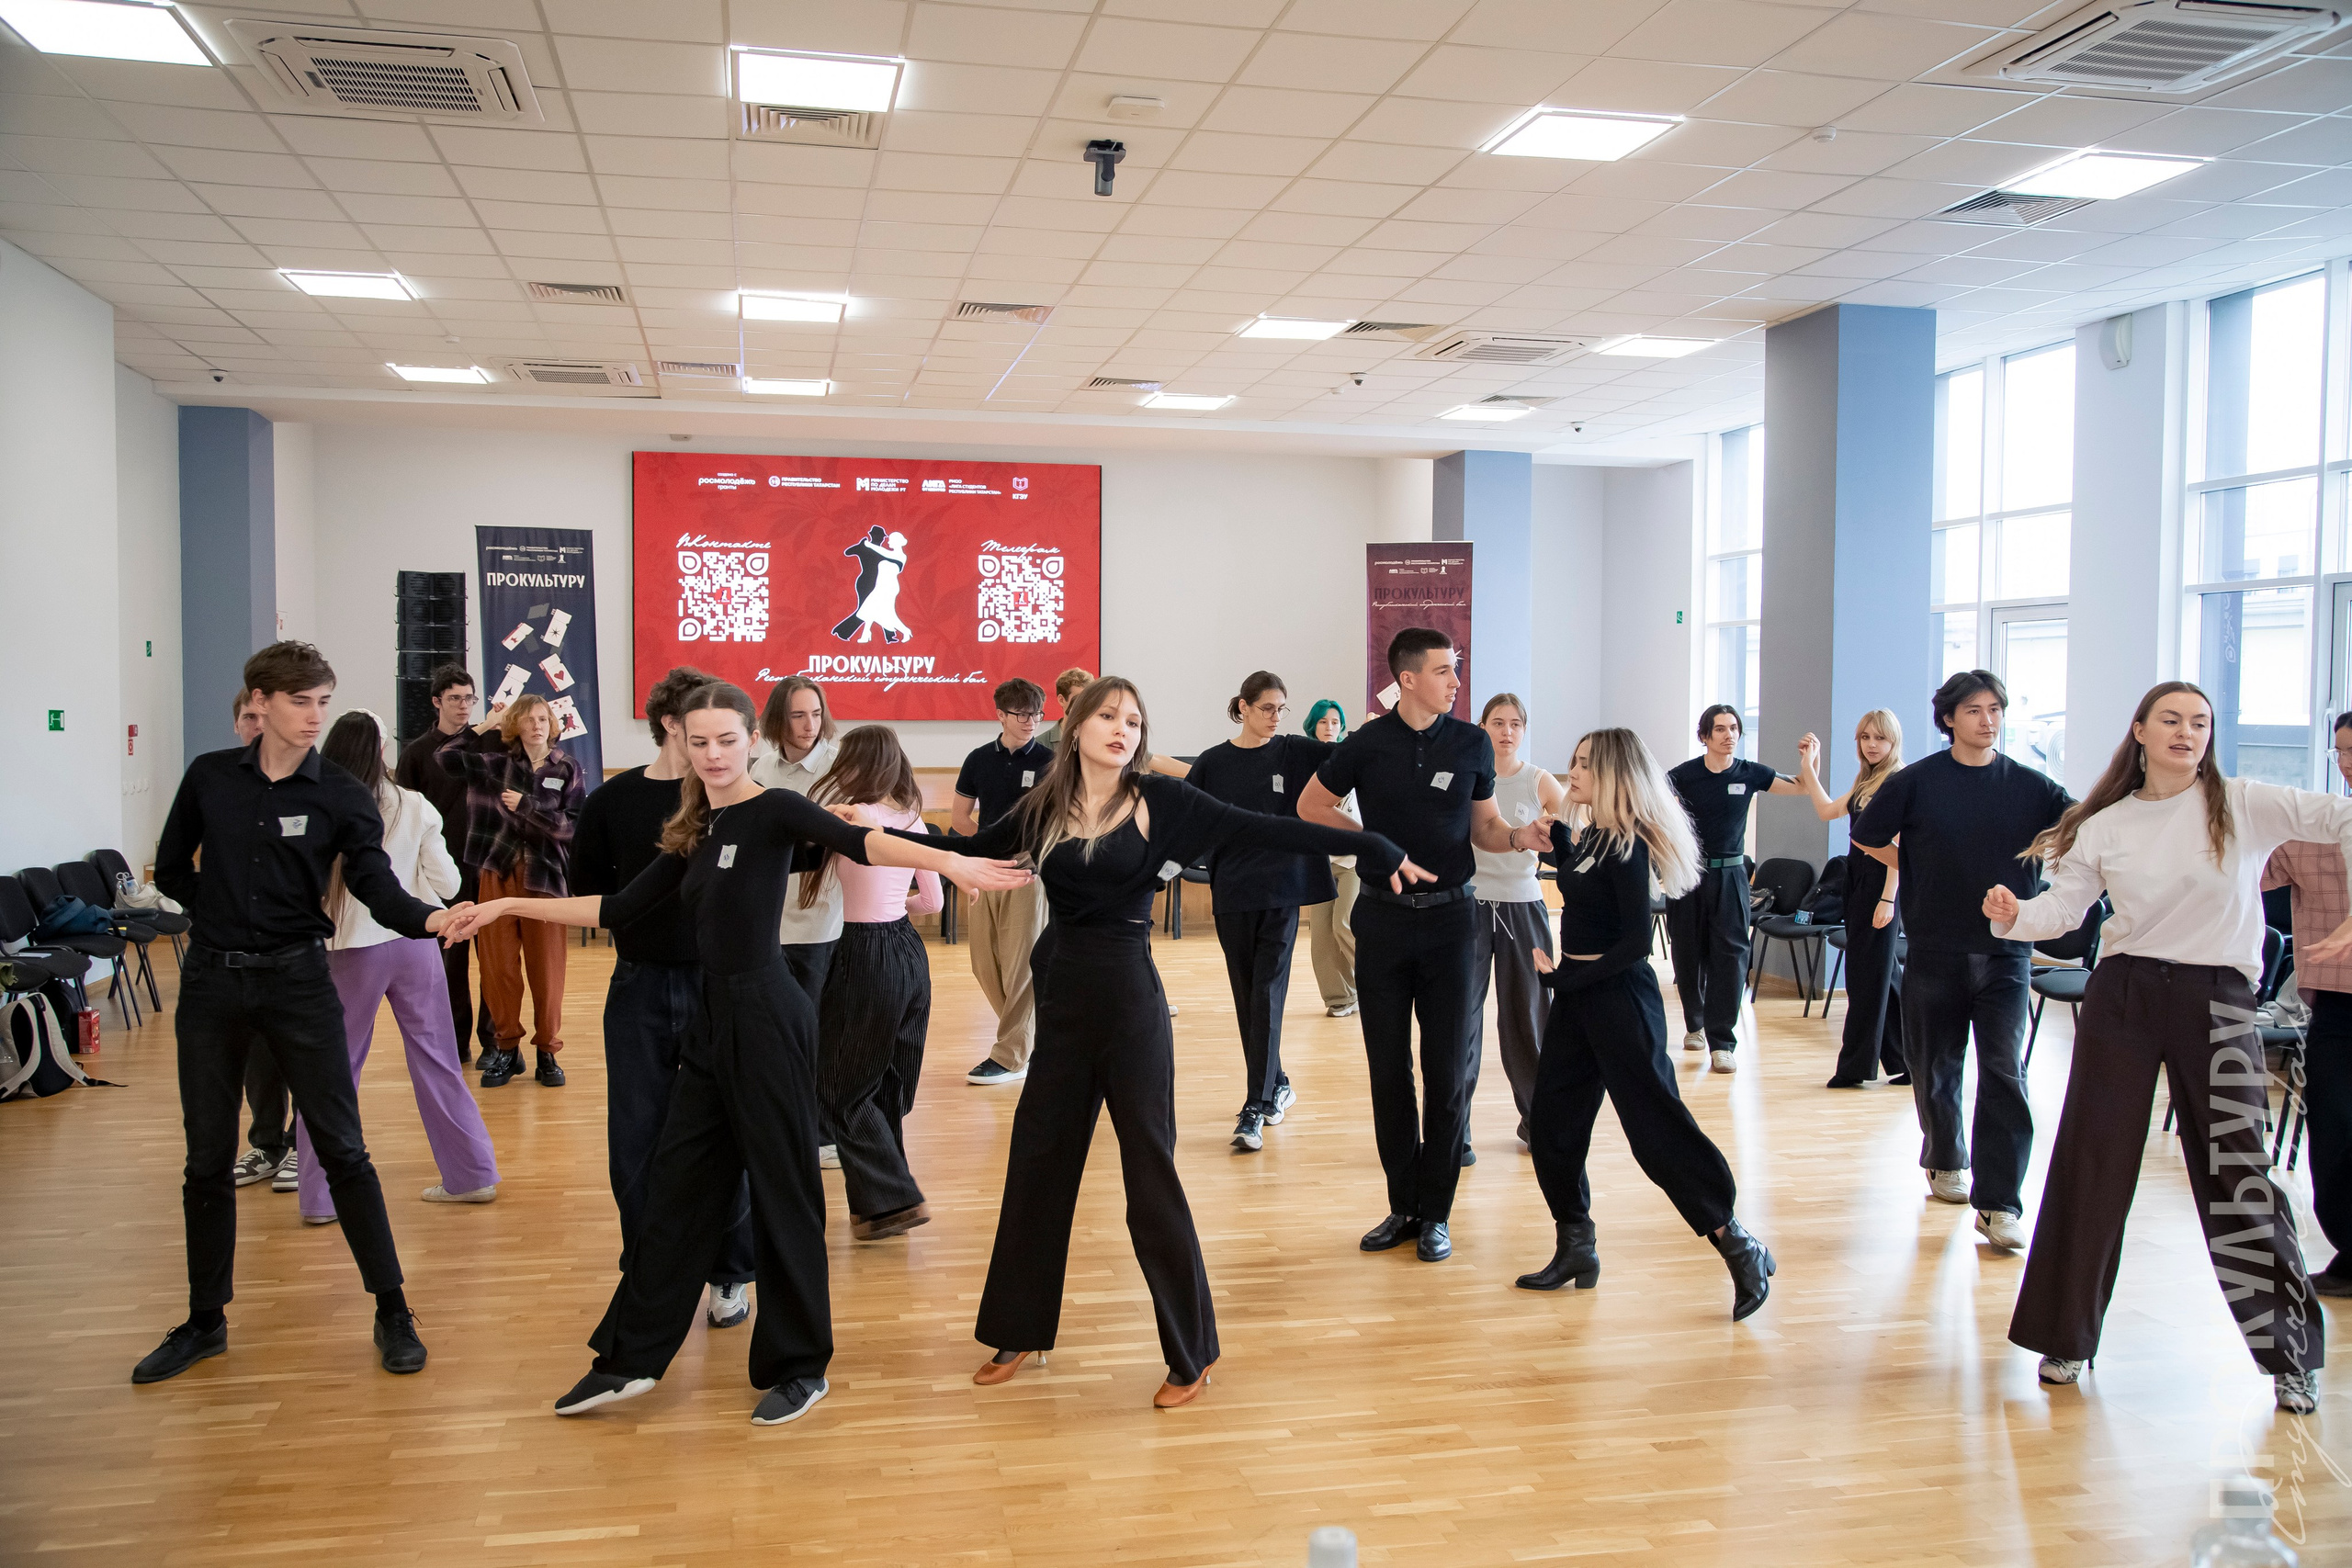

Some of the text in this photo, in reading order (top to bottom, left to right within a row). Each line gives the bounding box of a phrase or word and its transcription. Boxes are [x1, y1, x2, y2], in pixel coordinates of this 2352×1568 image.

[676, 532, 772, 548] ВКонтакте
[980, 539, 1061, 558] Телеграм
[486, 572, 585, 588] ПРОКУЛЬТУРУ
[1374, 587, 1464, 601] ПРОКУЛЬТУРУ
[808, 655, 935, 674] ПРОКУЛЬТУРУ
[962, 671, 989, 683] бал
